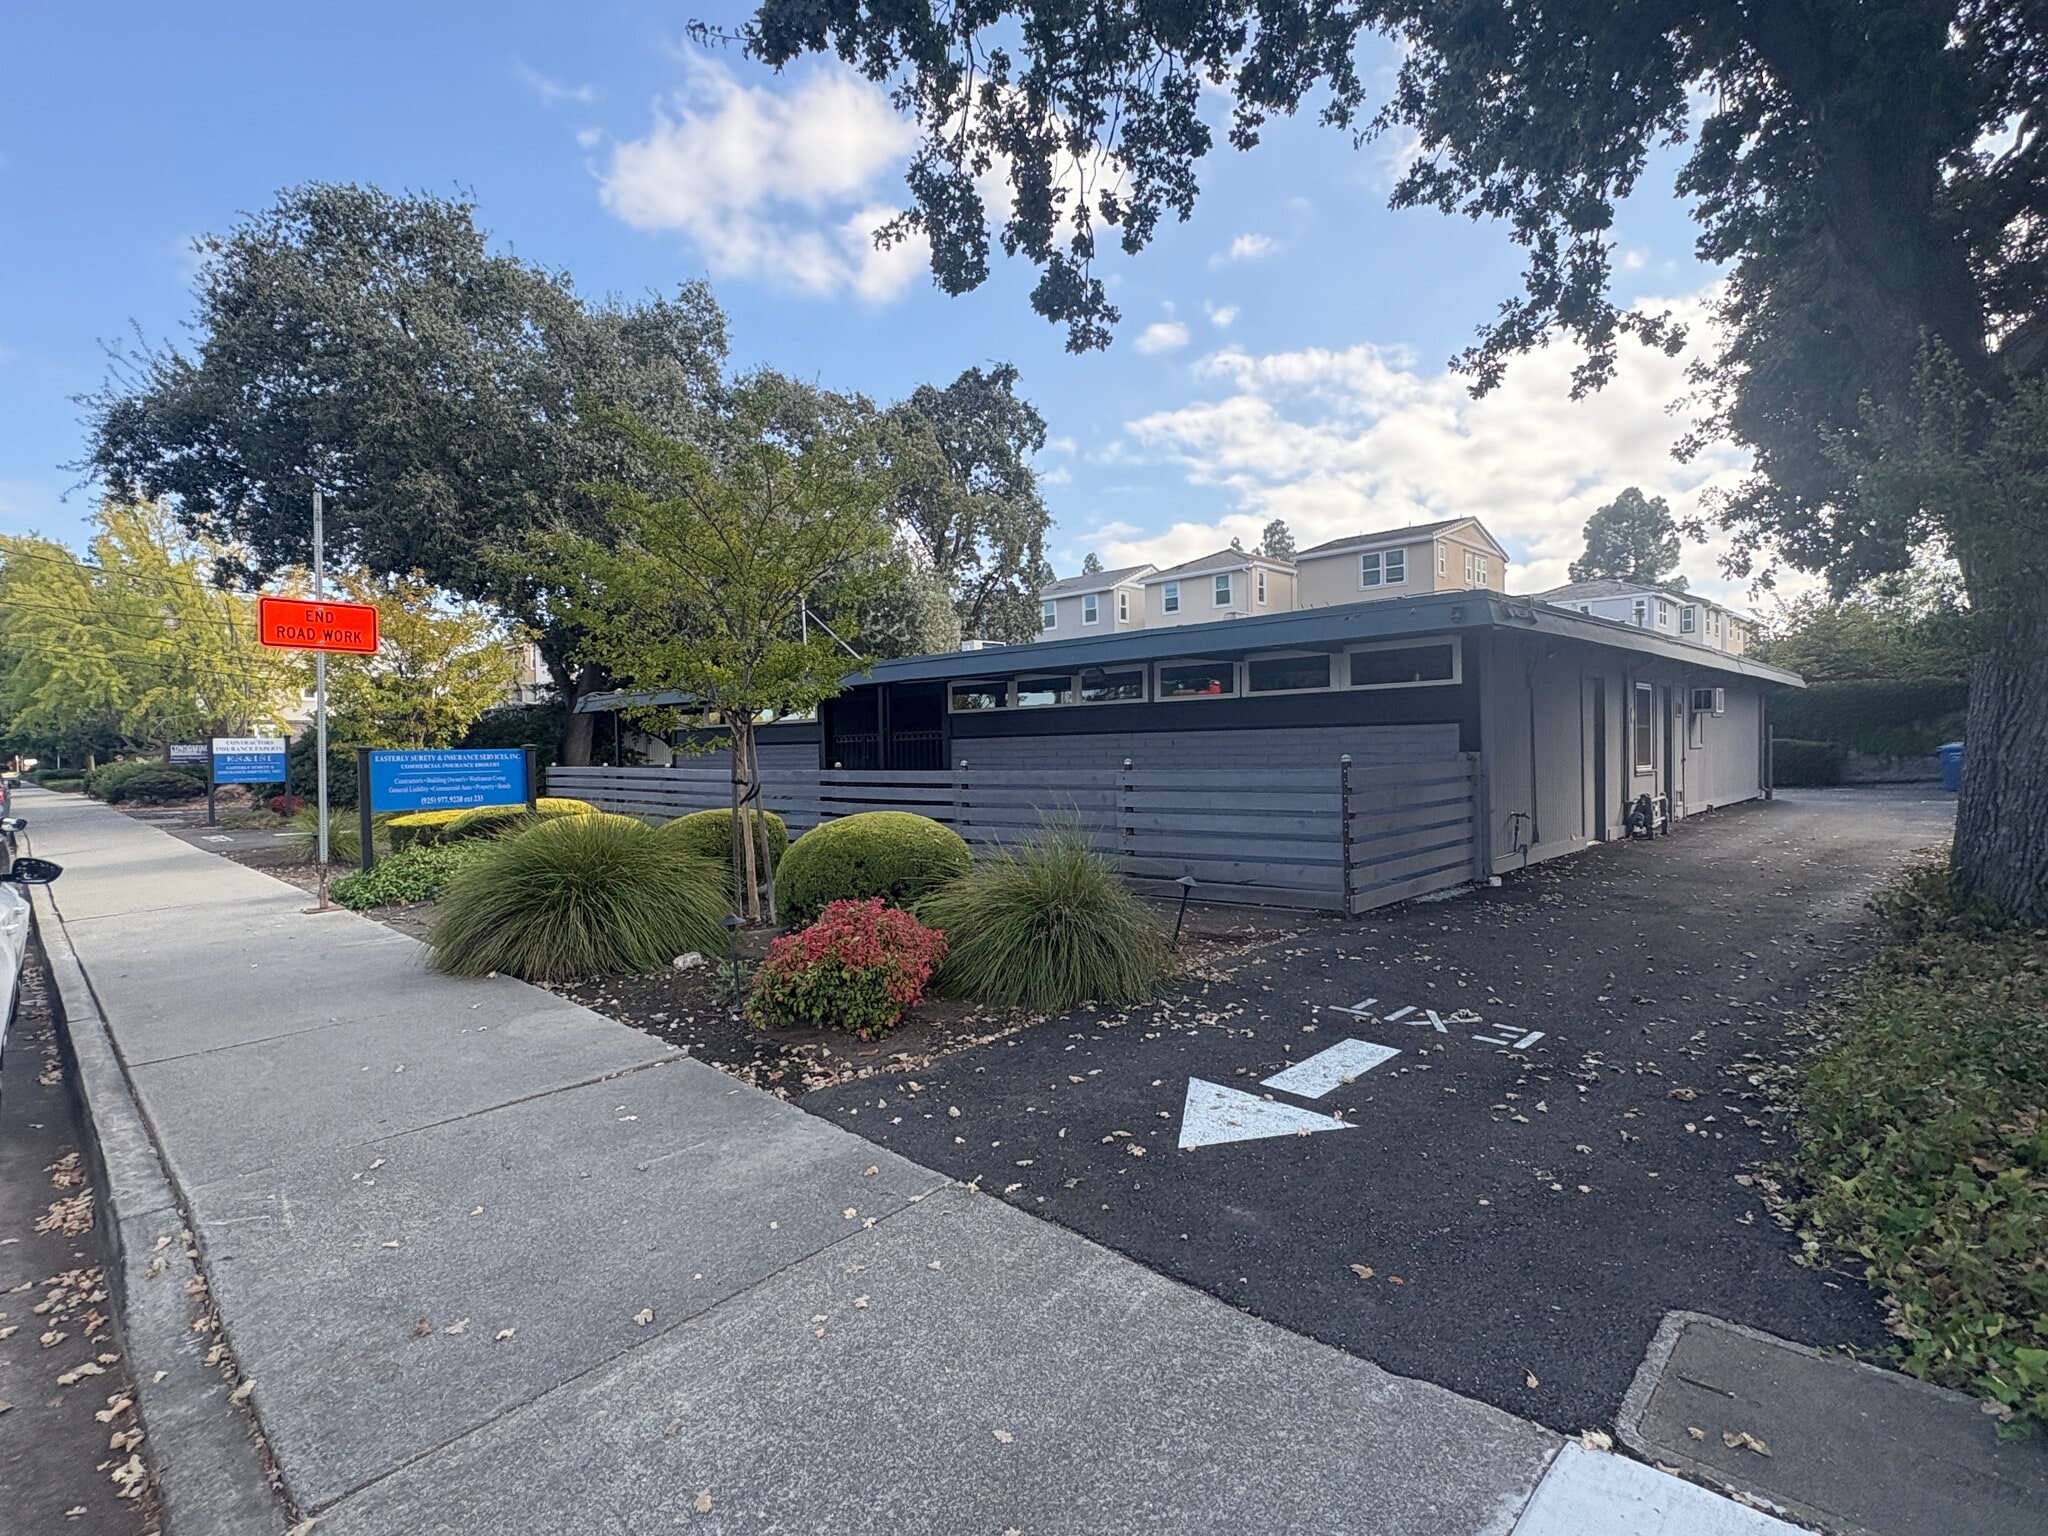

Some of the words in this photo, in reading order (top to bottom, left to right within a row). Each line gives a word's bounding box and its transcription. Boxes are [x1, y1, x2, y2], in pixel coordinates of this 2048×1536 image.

[305, 609, 334, 624] END
[276, 625, 316, 641] ROAD
[322, 629, 362, 643] WORK
[410, 754, 437, 762] SURETY
[443, 753, 480, 761] INSURANCE
[409, 785, 429, 794] Liability
[475, 783, 495, 791] Property
[421, 796, 437, 805] (925)
[1328, 998, 1546, 1050] EXIT
